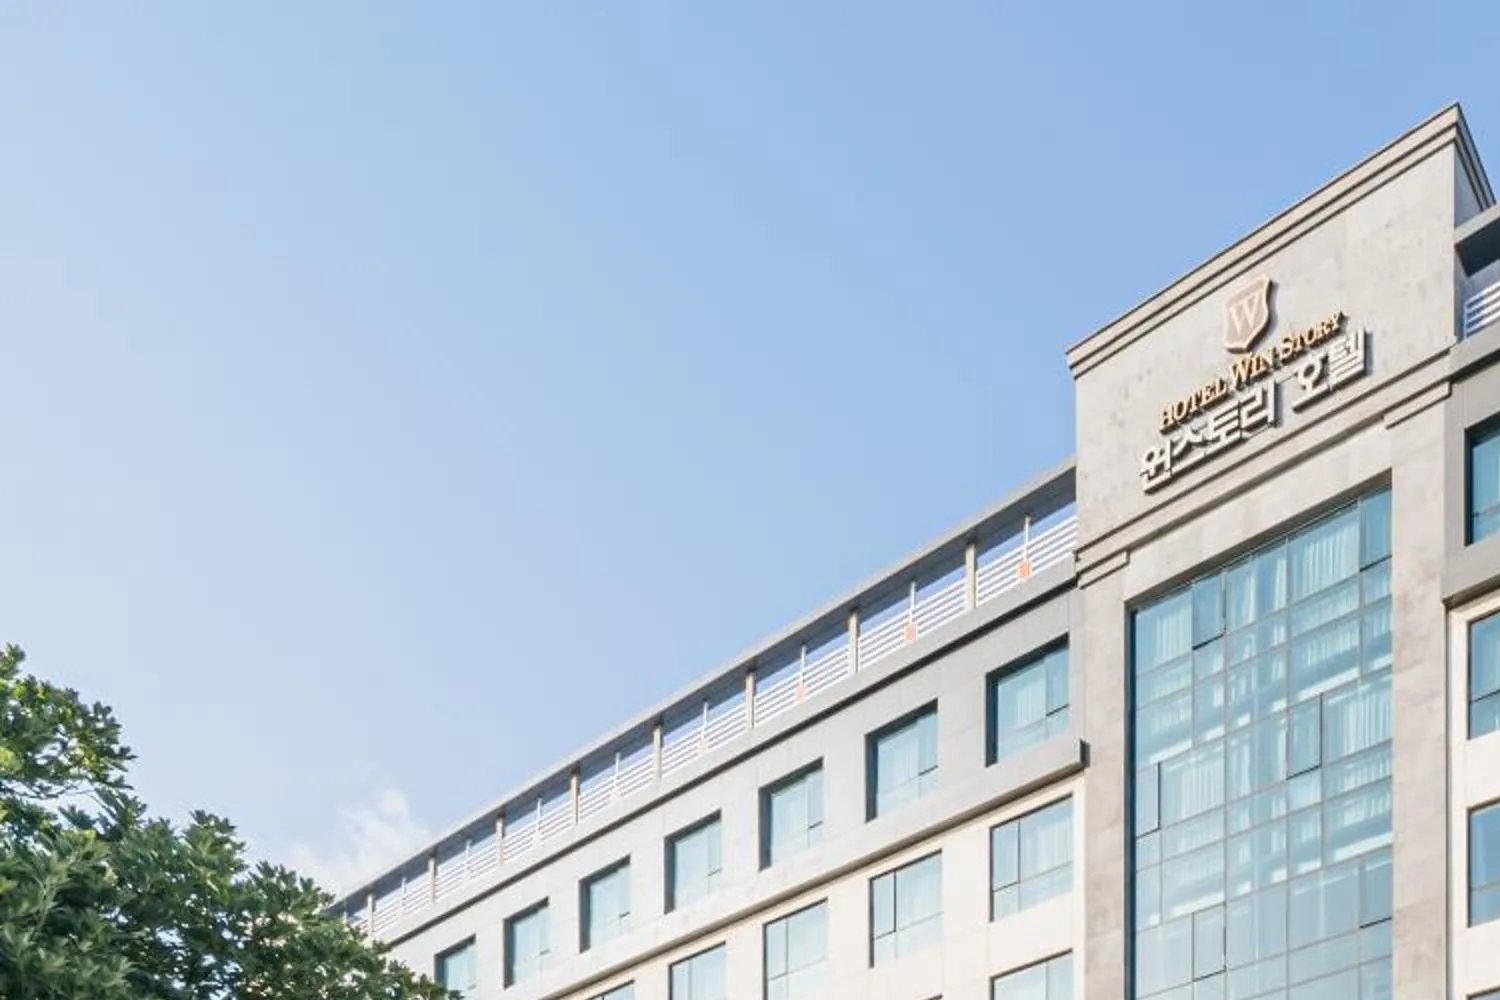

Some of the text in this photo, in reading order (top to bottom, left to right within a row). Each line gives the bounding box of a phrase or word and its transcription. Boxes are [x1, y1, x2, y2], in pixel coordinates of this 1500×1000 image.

[1159, 376, 1228, 427] HOTEL
[1279, 311, 1345, 358] STORY
[1291, 327, 1365, 410] 호텔
